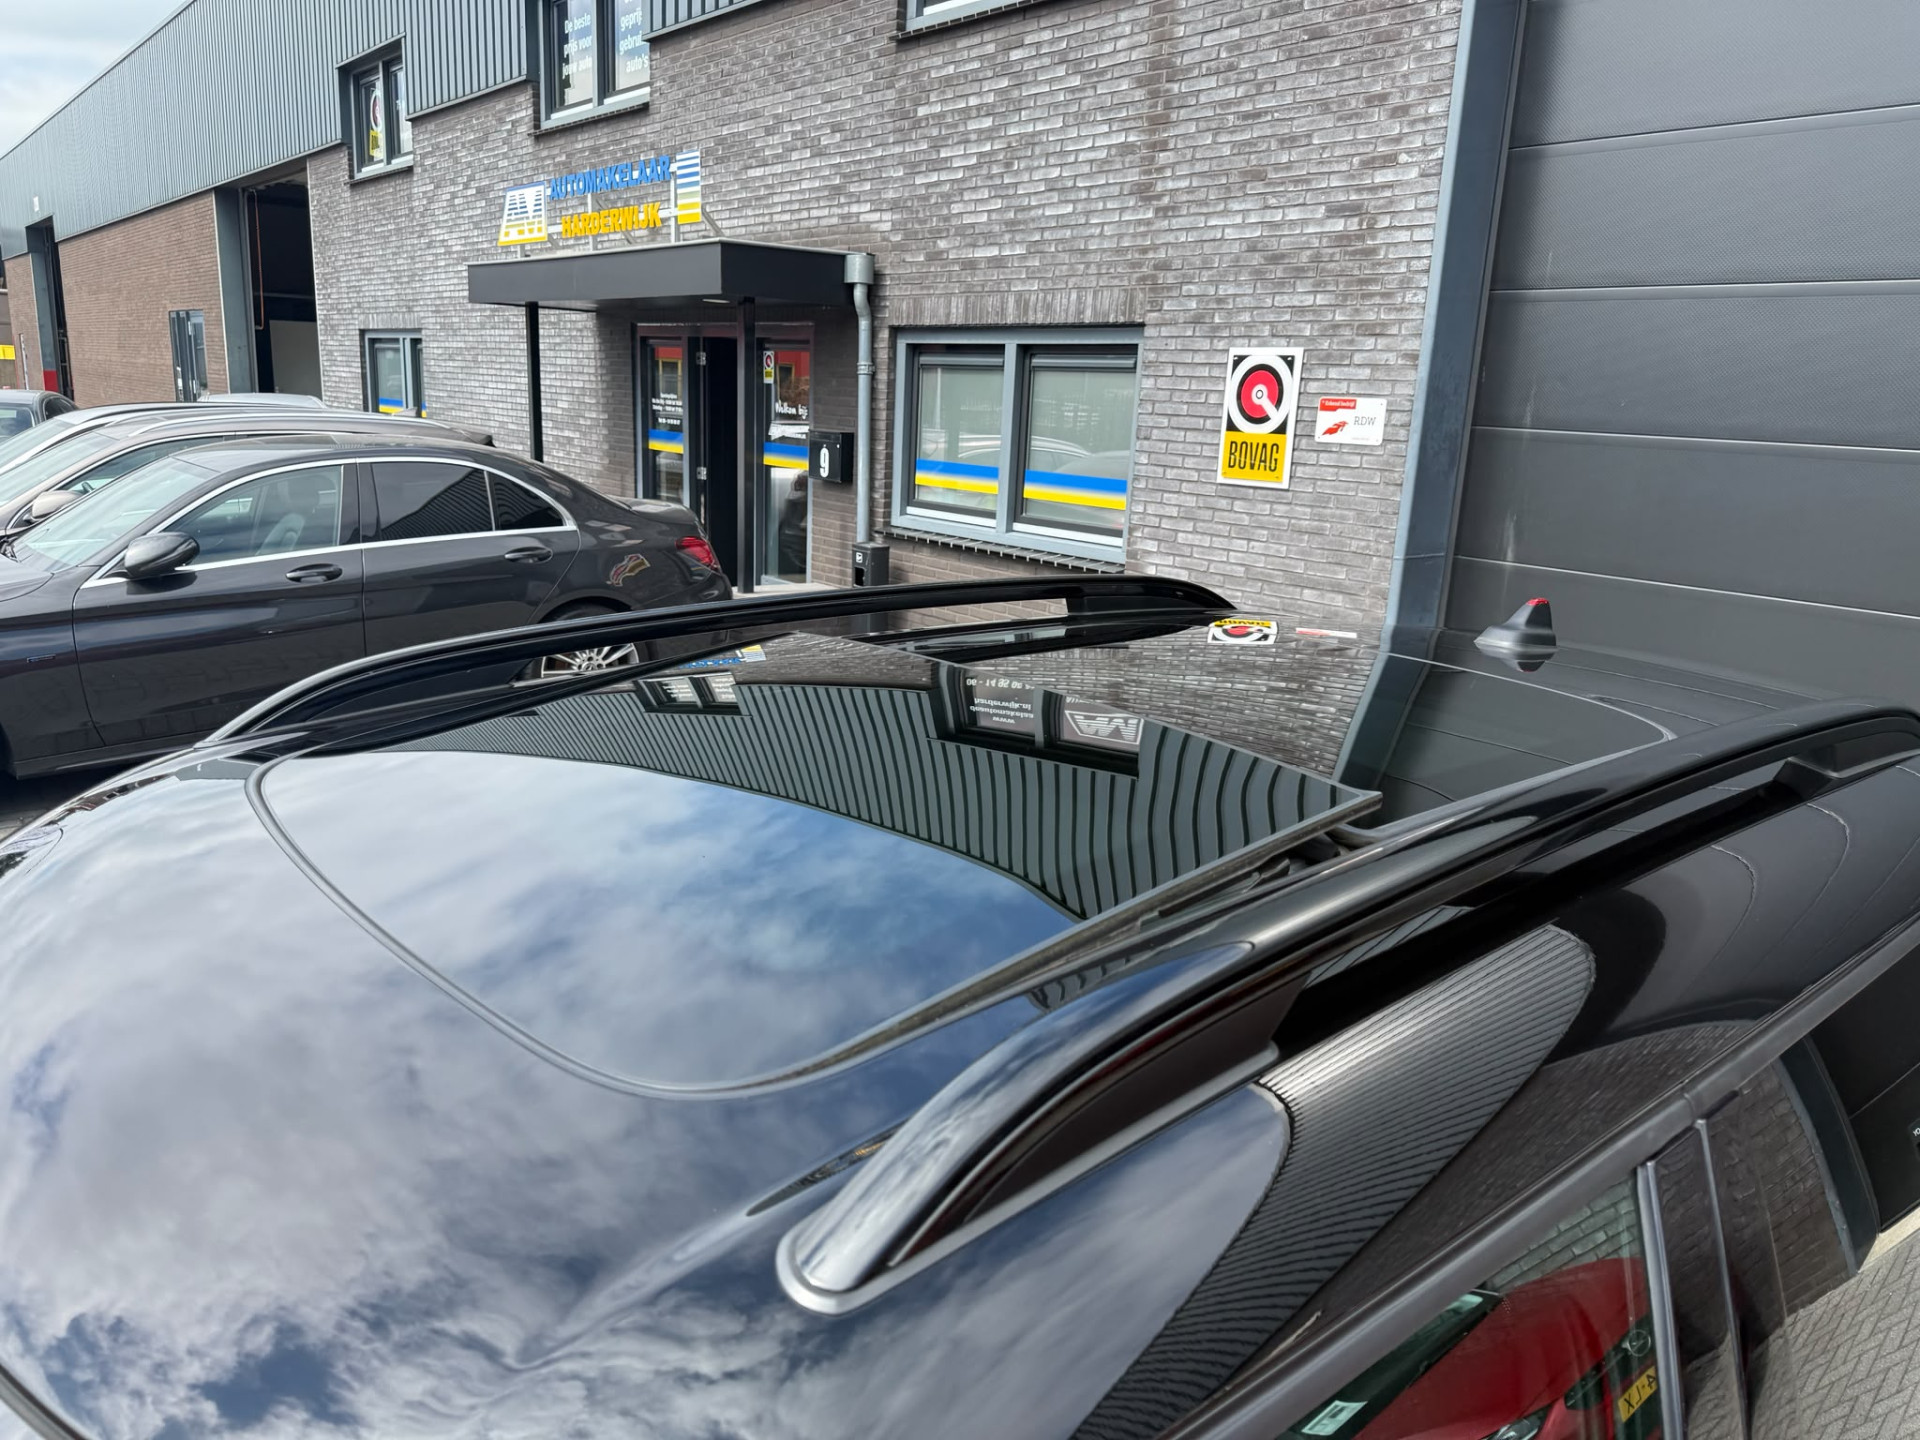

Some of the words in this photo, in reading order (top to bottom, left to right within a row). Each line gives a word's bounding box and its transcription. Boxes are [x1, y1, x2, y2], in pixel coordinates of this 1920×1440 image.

[564, 20, 573, 34] De
[573, 13, 591, 31] beste
[563, 39, 578, 58] prijs
[626, 53, 649, 73] auto's
[550, 154, 672, 200] AUTOMAKELAAR
[561, 201, 662, 239] HARDERWIJK
[1353, 415, 1376, 426] RDW
[820, 447, 829, 478] 9
[1228, 441, 1280, 472] BOVAG
